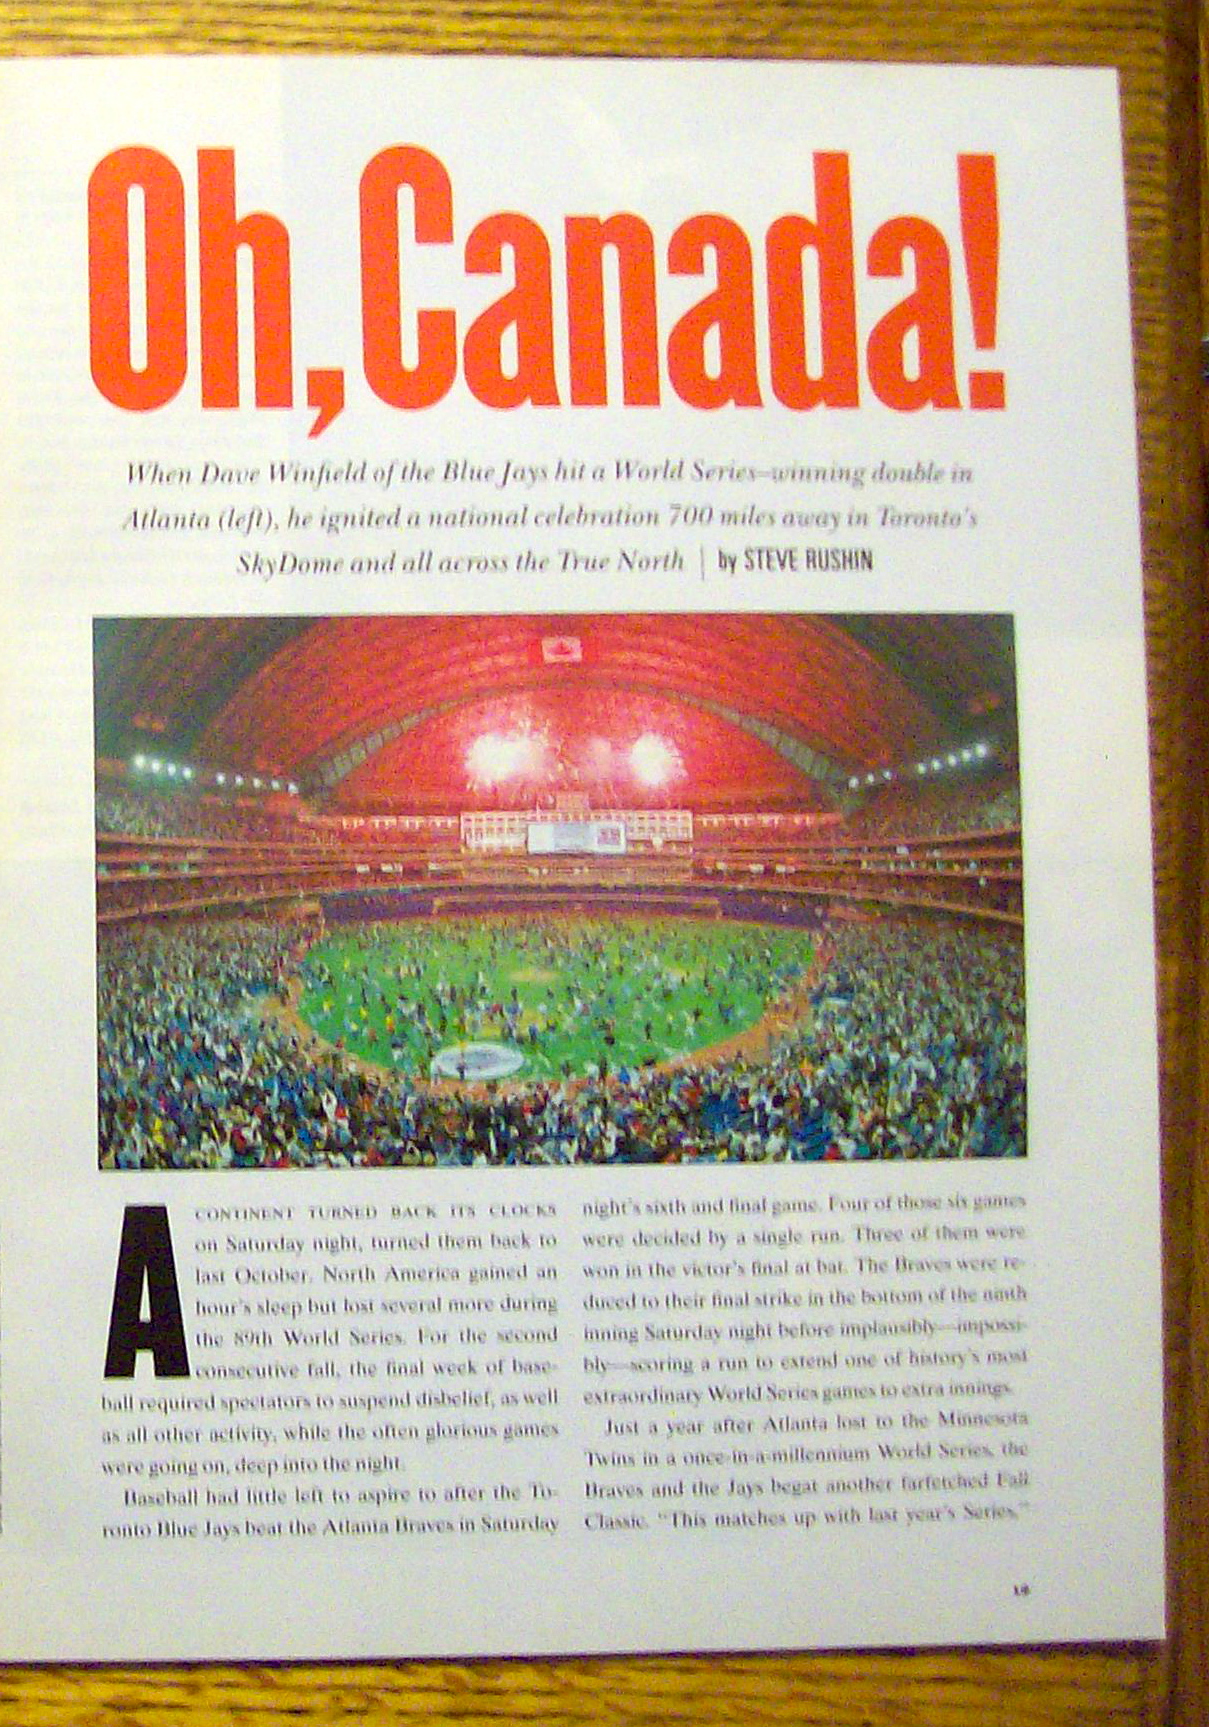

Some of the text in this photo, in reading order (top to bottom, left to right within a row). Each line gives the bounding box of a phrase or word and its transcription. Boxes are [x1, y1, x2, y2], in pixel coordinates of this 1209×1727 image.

[87, 144, 1006, 438] Oh, Canada!
[127, 460, 192, 486] When
[199, 461, 261, 486] Dave
[269, 459, 368, 489] Winfield
[372, 459, 395, 488] of
[400, 459, 436, 482] the
[442, 459, 496, 482] Blue
[494, 459, 548, 488] Jays
[554, 460, 587, 482] hit
[590, 465, 606, 482] a
[613, 458, 685, 482] World
[871, 461, 945, 483] double
[951, 463, 974, 483] in
[121, 505, 211, 532] Atlanta
[286, 505, 314, 530] he
[319, 504, 402, 536] ignited
[406, 511, 421, 529] a
[427, 503, 530, 529] national
[533, 502, 661, 528] celebration
[669, 502, 715, 527] 700
[719, 503, 777, 527] miles
[781, 510, 842, 532] away
[846, 508, 870, 528] in
[235, 546, 875, 579] SkyDome and all across the True North by STEVE RUSHIN
[645, 1197, 687, 1216] sixth
[691, 1197, 725, 1215] and
[728, 1195, 768, 1215] final
[828, 1193, 871, 1213] Four
[873, 1194, 894, 1212] of
[896, 1193, 943, 1211] those
[947, 1192, 969, 1210] six
[972, 1195, 1028, 1213] games
[194, 1239, 219, 1254] on
[225, 1234, 305, 1258] Saturday
[370, 1231, 430, 1252] turned
[437, 1232, 483, 1251] them
[489, 1230, 532, 1250] back
[538, 1233, 558, 1249] to
[195, 1266, 226, 1286] last
[322, 1264, 376, 1284] North
[384, 1265, 461, 1283] America
[468, 1263, 528, 1286] gained
[535, 1266, 558, 1281] an
[103, 1204, 191, 1379] A
[308, 1205, 378, 1221] TURNED
[390, 1204, 438, 1220] BACK
[450, 1203, 477, 1219] ITS
[488, 1203, 558, 1218] CLOCKS
[256, 1298, 303, 1321] sleep
[307, 1297, 337, 1316] but
[343, 1296, 375, 1315] lost
[380, 1295, 442, 1315] several
[447, 1298, 495, 1313] more
[499, 1293, 559, 1317] during
[195, 1331, 224, 1349] the
[282, 1328, 340, 1347] World
[417, 1326, 450, 1346] For
[459, 1326, 488, 1345] the
[496, 1325, 559, 1344] second
[195, 1363, 300, 1380] consecutive
[349, 1360, 378, 1378] the
[385, 1358, 425, 1378] final
[432, 1358, 478, 1377] week
[485, 1358, 506, 1376] of
[100, 1393, 134, 1414] ball
[139, 1392, 216, 1416] required
[220, 1395, 312, 1416] spectators
[315, 1394, 335, 1410] to
[338, 1390, 412, 1414] suspend
[500, 1393, 520, 1407] as
[522, 1387, 559, 1407] well
[582, 1385, 704, 1408] extraordinary
[707, 1384, 763, 1403] World
[766, 1383, 820, 1402] Series
[821, 1385, 877, 1405] games
[879, 1383, 899, 1399] to
[901, 1383, 945, 1399] extra
[101, 1430, 121, 1445] as
[126, 1425, 148, 1445] all
[153, 1426, 203, 1444] other
[282, 1422, 331, 1442] while
[337, 1422, 367, 1441] the
[371, 1423, 420, 1441] often
[425, 1420, 498, 1445] glorious
[502, 1423, 560, 1444] games
[100, 1461, 145, 1476] were
[148, 1459, 199, 1480] going
[234, 1456, 279, 1479] deep
[282, 1457, 319, 1474] into
[322, 1454, 351, 1473] the
[123, 1488, 199, 1508] Baseball
[205, 1487, 239, 1507] had
[246, 1487, 288, 1506] little
[294, 1485, 324, 1505] left
[331, 1488, 351, 1505] to
[357, 1486, 411, 1508] aspire
[418, 1487, 437, 1503] to
[443, 1484, 486, 1503] after
[492, 1483, 522, 1502] the
[584, 1481, 645, 1500] Braves
[651, 1479, 685, 1499] and
[691, 1479, 720, 1497] the
[727, 1477, 764, 1500] Jays
[770, 1476, 819, 1498] begat
[825, 1476, 893, 1494] another
[996, 1470, 1031, 1489] Fall
[157, 1519, 199, 1539] Blue
[202, 1519, 241, 1542] Jays
[244, 1519, 283, 1538] beat
[288, 1518, 318, 1537] the
[321, 1518, 390, 1536] Atlanta
[395, 1516, 456, 1535] Braves
[459, 1516, 476, 1534] in
[480, 1514, 560, 1537] Saturday
